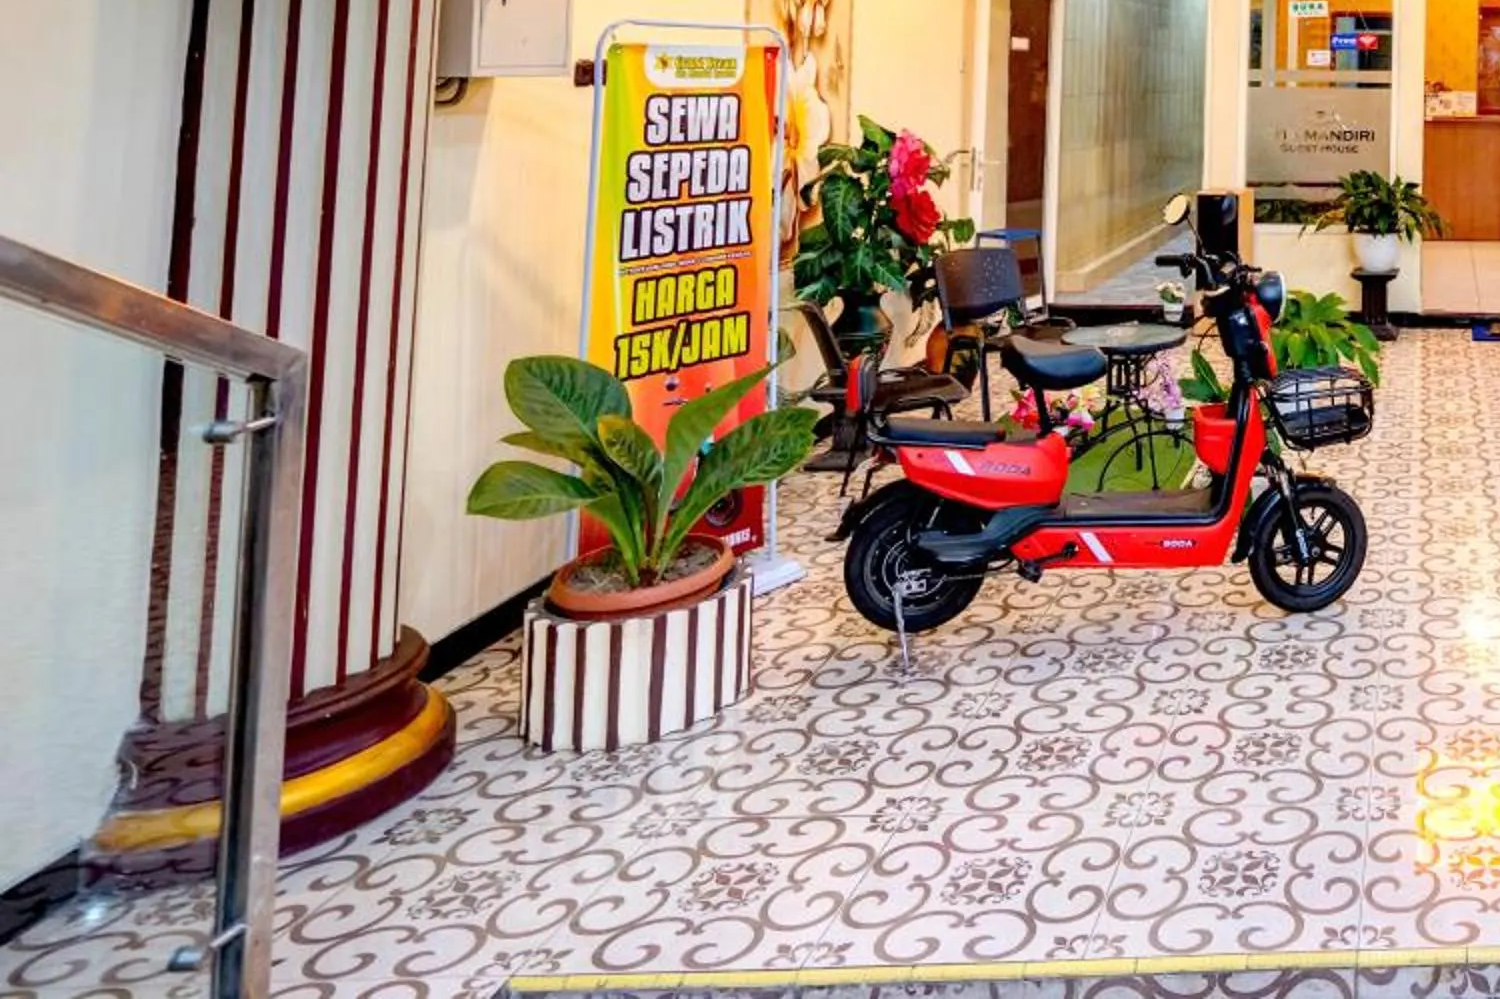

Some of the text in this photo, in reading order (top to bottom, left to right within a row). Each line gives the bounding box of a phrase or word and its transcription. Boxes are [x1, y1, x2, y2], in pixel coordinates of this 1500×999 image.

[645, 95, 740, 145] SEWA
[627, 147, 750, 204] SEPEDA
[620, 197, 752, 262] LISTRIK
[633, 266, 737, 325] HARGA
[616, 313, 749, 380] 15K/JAM
